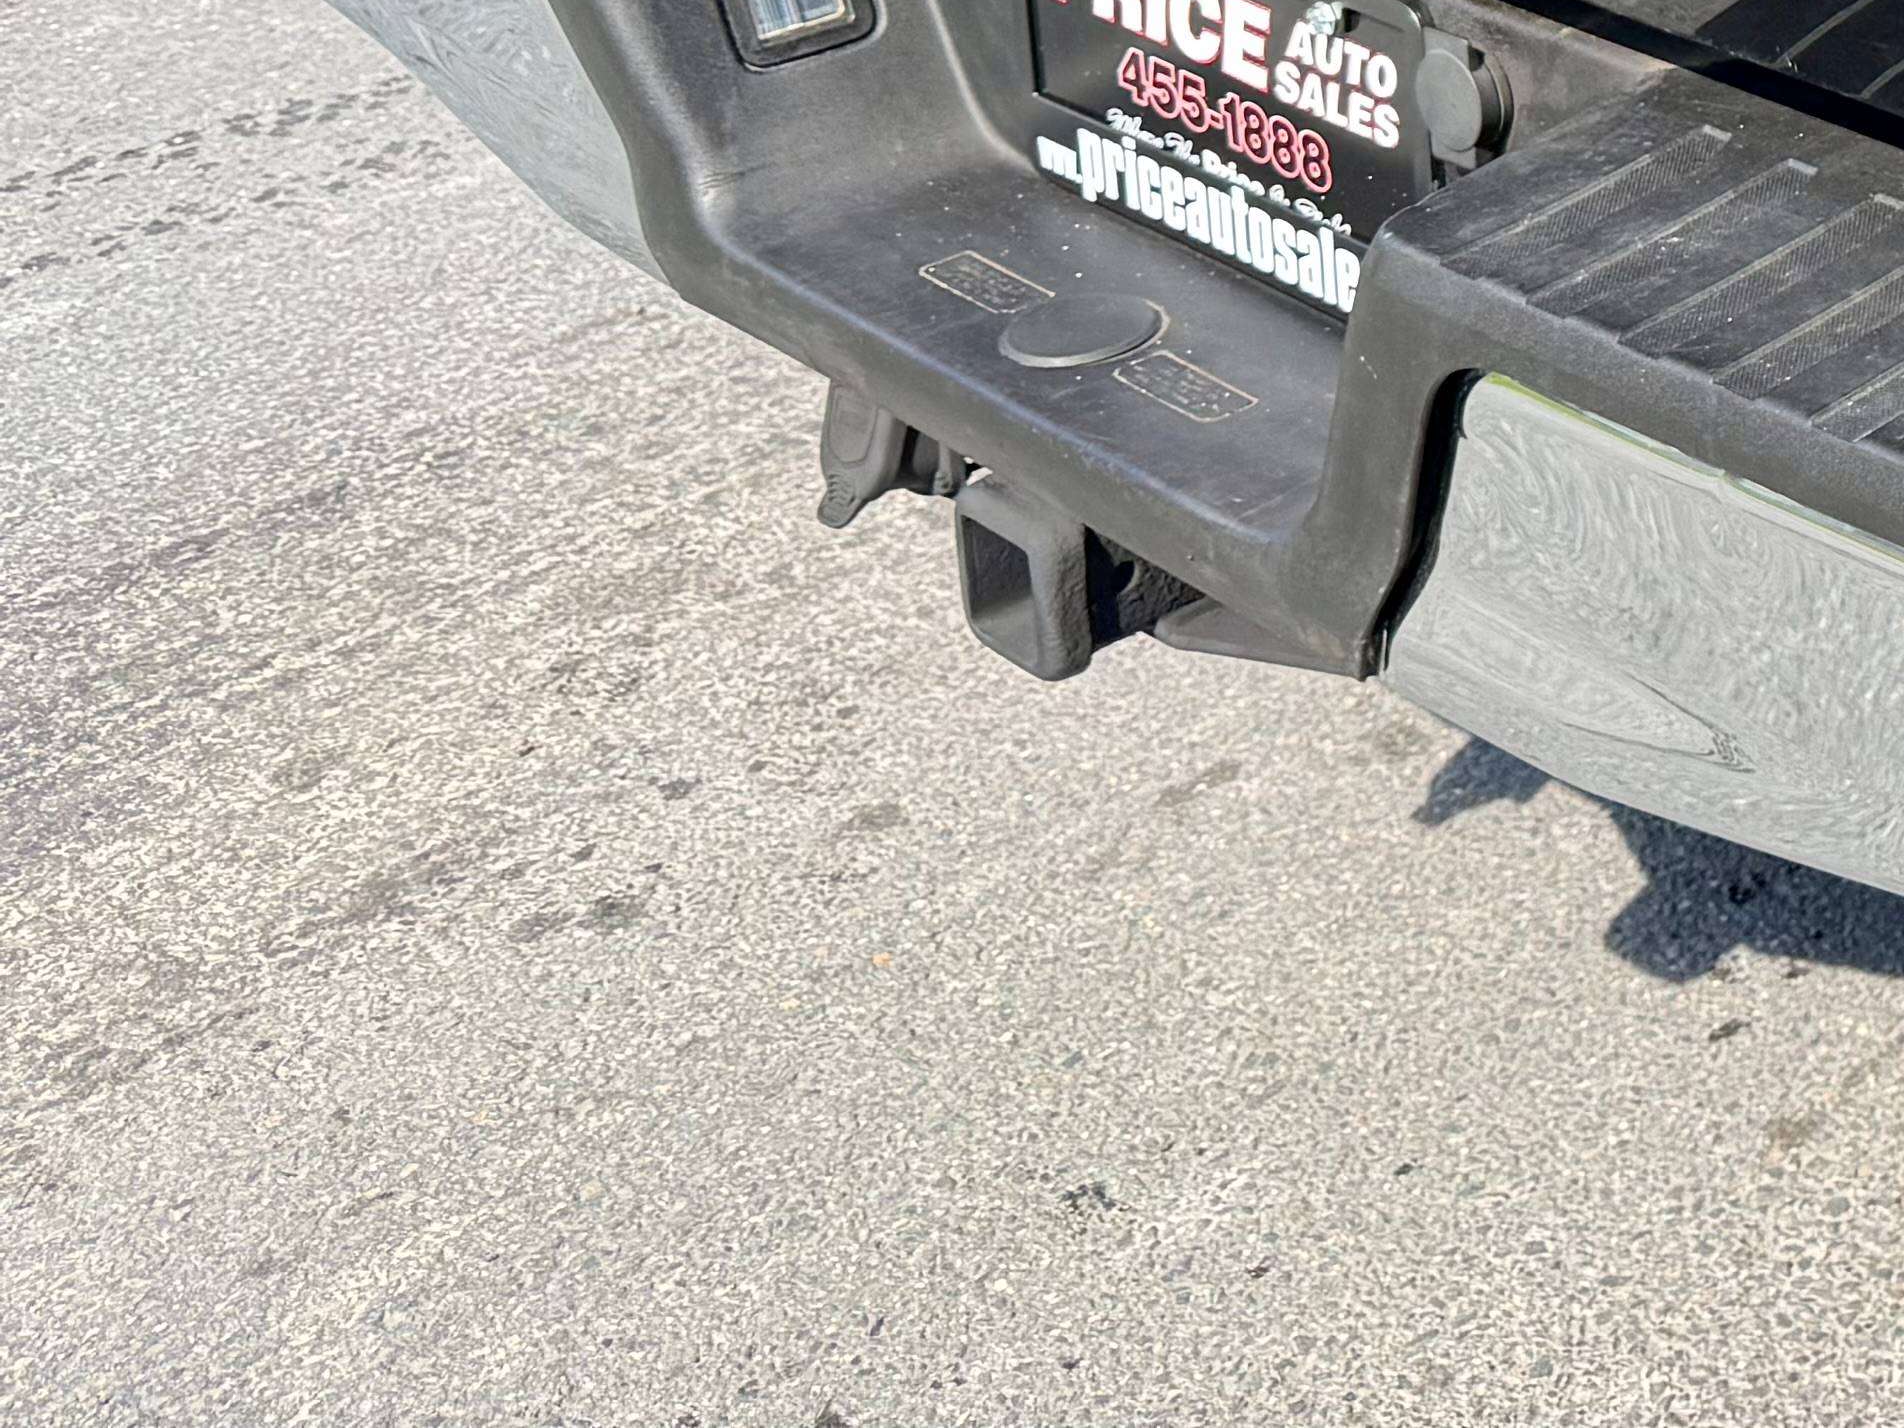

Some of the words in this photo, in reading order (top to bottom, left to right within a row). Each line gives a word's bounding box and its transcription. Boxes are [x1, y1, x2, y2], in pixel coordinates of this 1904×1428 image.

[1283, 16, 1399, 99] AUTO
[1116, 45, 1334, 194] 455-1888
[1272, 60, 1401, 149] SALES
